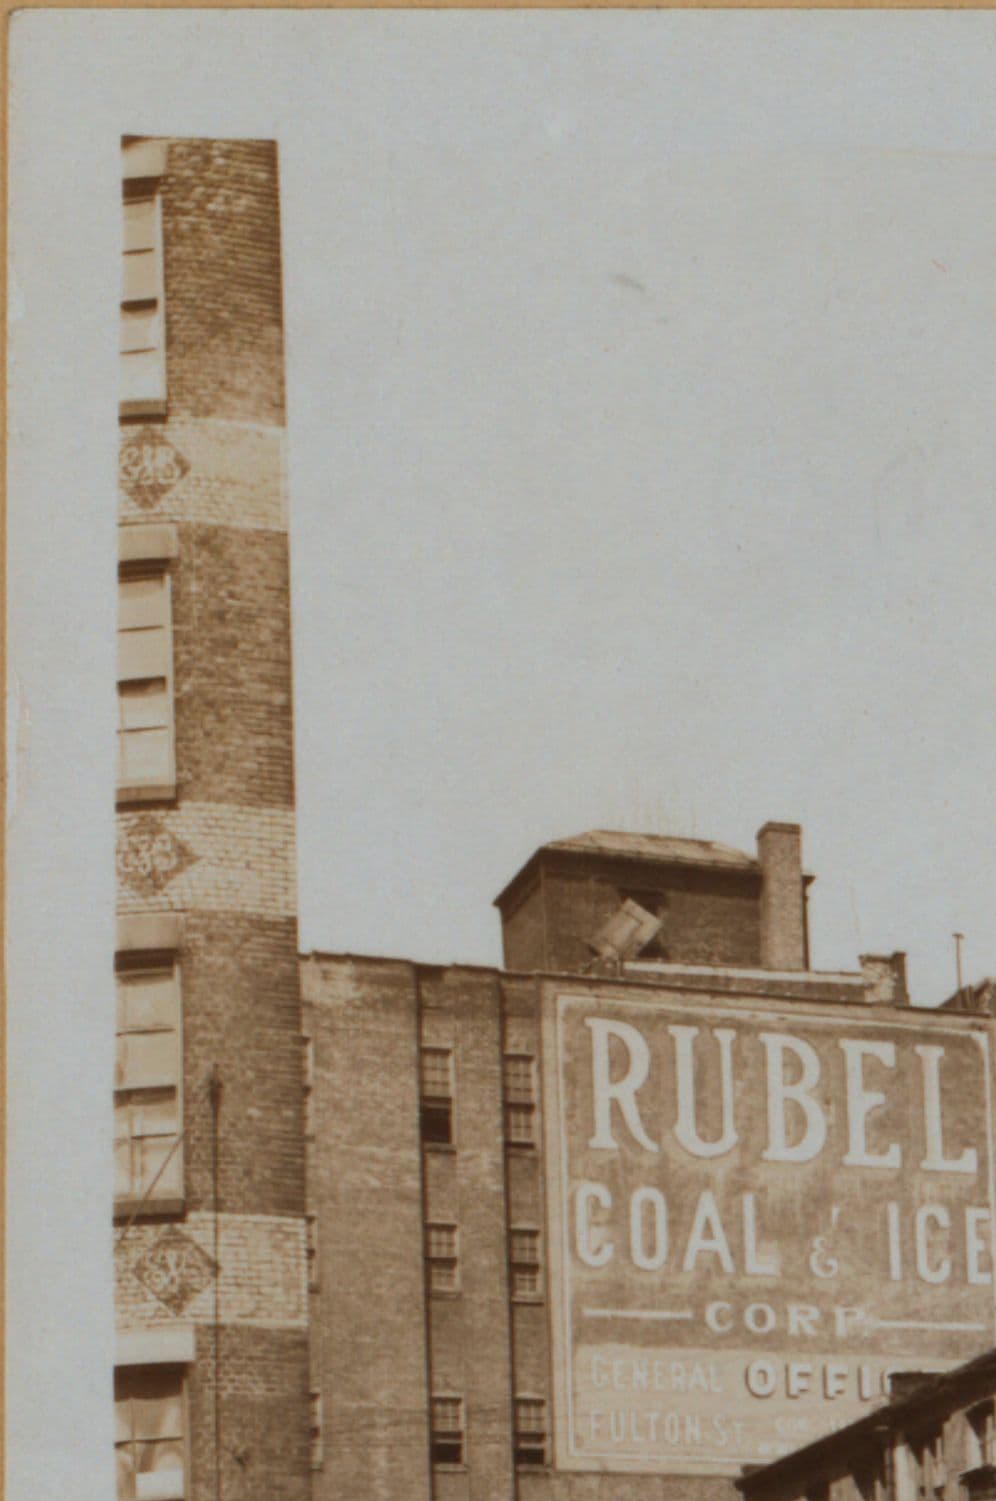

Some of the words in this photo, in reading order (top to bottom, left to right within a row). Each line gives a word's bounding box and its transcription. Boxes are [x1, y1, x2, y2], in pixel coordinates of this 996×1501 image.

[584, 1016, 979, 1174] RUBEL
[574, 1180, 781, 1277] COAL
[887, 1200, 993, 1285] ICE
[591, 1359, 722, 1394] GENERAL
[589, 1408, 702, 1445] FULTON
